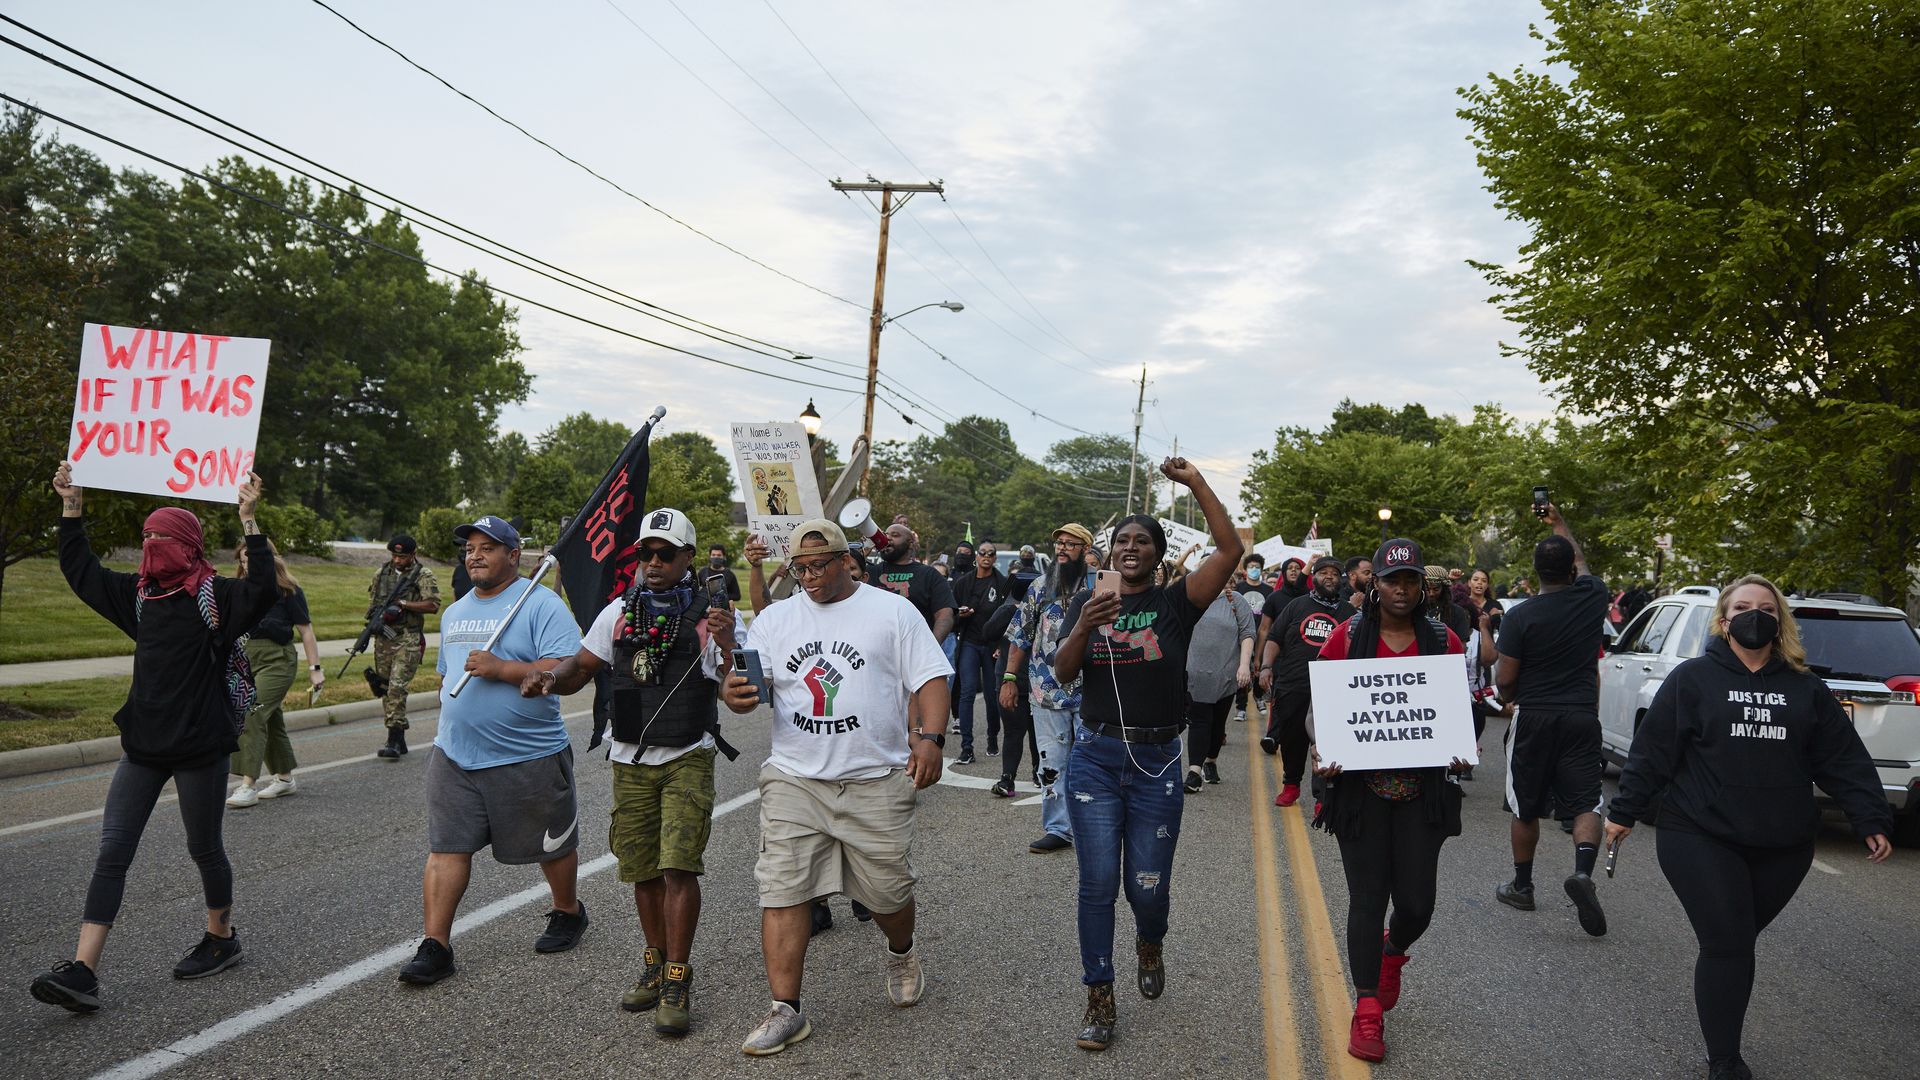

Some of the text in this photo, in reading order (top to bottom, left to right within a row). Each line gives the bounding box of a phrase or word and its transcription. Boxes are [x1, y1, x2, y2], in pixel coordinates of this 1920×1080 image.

[101, 325, 231, 374] WHAT
[81, 374, 256, 417] IF IT WAS
[72, 418, 172, 462] YOUR
[734, 441, 801, 452] JAYLAND WALKER
[742, 451, 752, 460] I
[789, 450, 800, 461] 25
[166, 445, 255, 493] SON?
[888, 572, 914, 582] STOP
[1114, 611, 1158, 631] STOP
[1308, 619, 1333, 631] BLACK
[786, 640, 865, 674] BLACK LIVES
[1348, 672, 1427, 689] JUSTICE
[1370, 691, 1408, 705] FOR
[1728, 690, 1787, 706] JUSTICE
[1346, 708, 1436, 725] JAYLAND
[1743, 706, 1771, 722] FOR
[793, 711, 861, 735] MATTER
[1730, 723, 1787, 740] JAYLAND
[1353, 726, 1434, 742] WALKER
